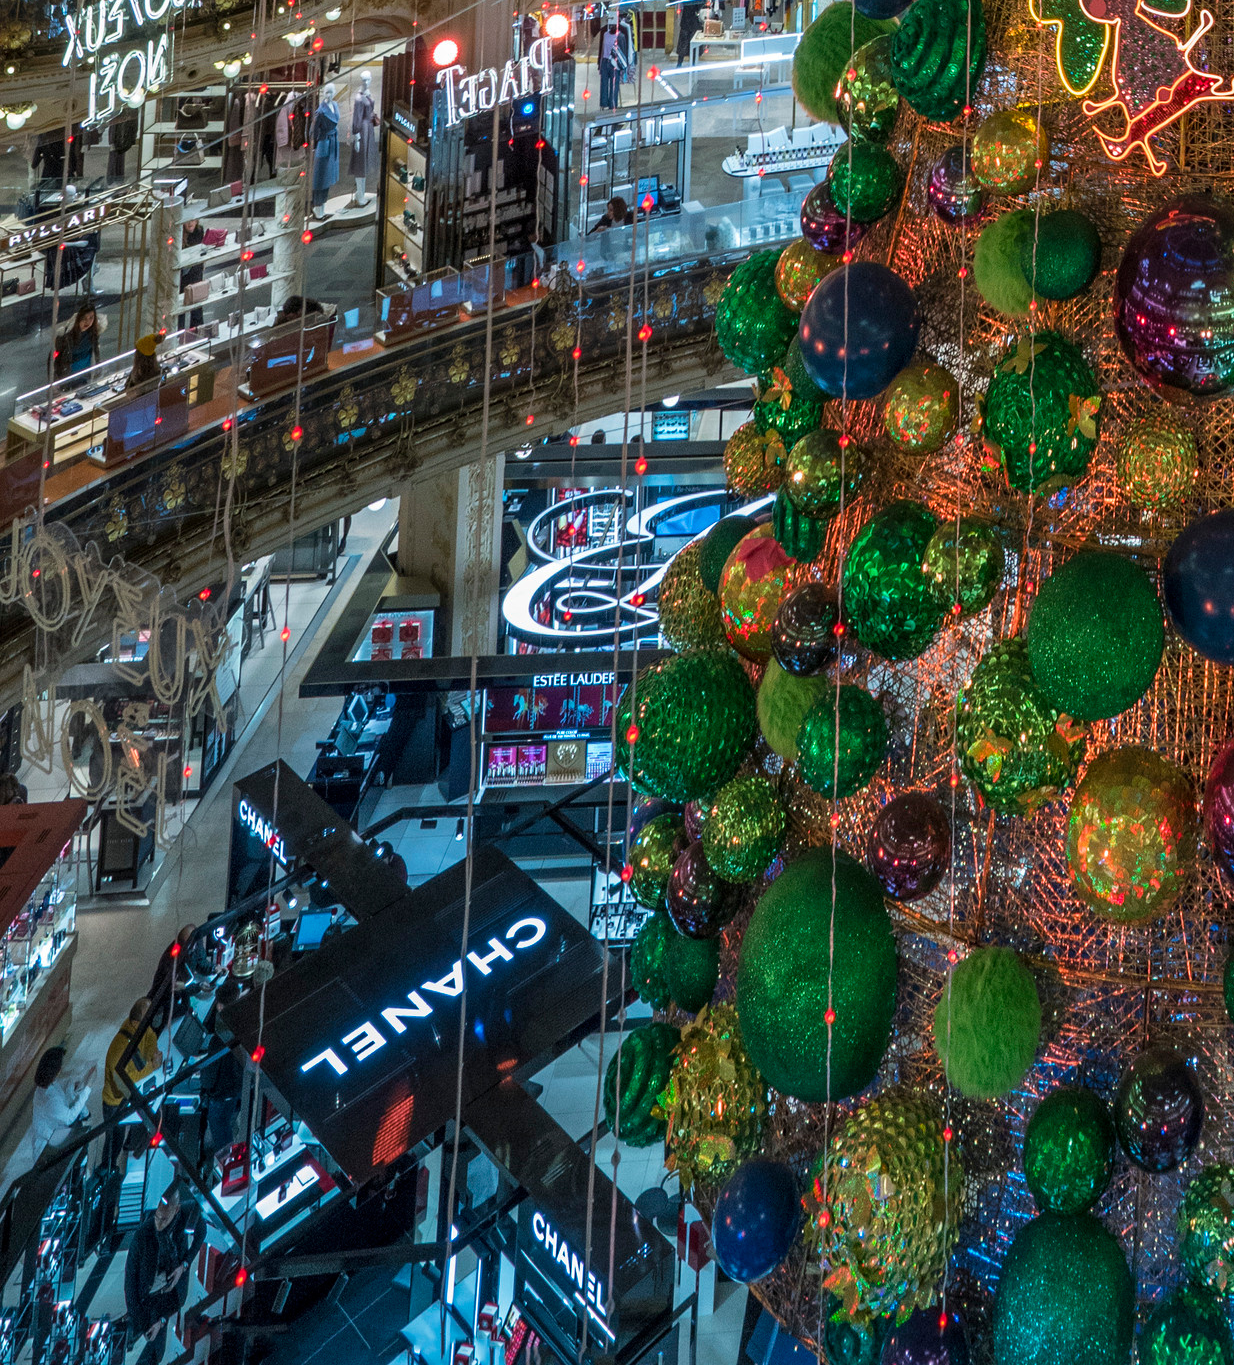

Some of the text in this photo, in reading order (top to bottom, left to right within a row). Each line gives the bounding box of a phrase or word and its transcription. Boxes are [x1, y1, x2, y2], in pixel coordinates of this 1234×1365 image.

[239, 799, 287, 866] CHANEL
[300, 917, 547, 1076] CHANEL
[532, 1211, 607, 1317] CHANEL
